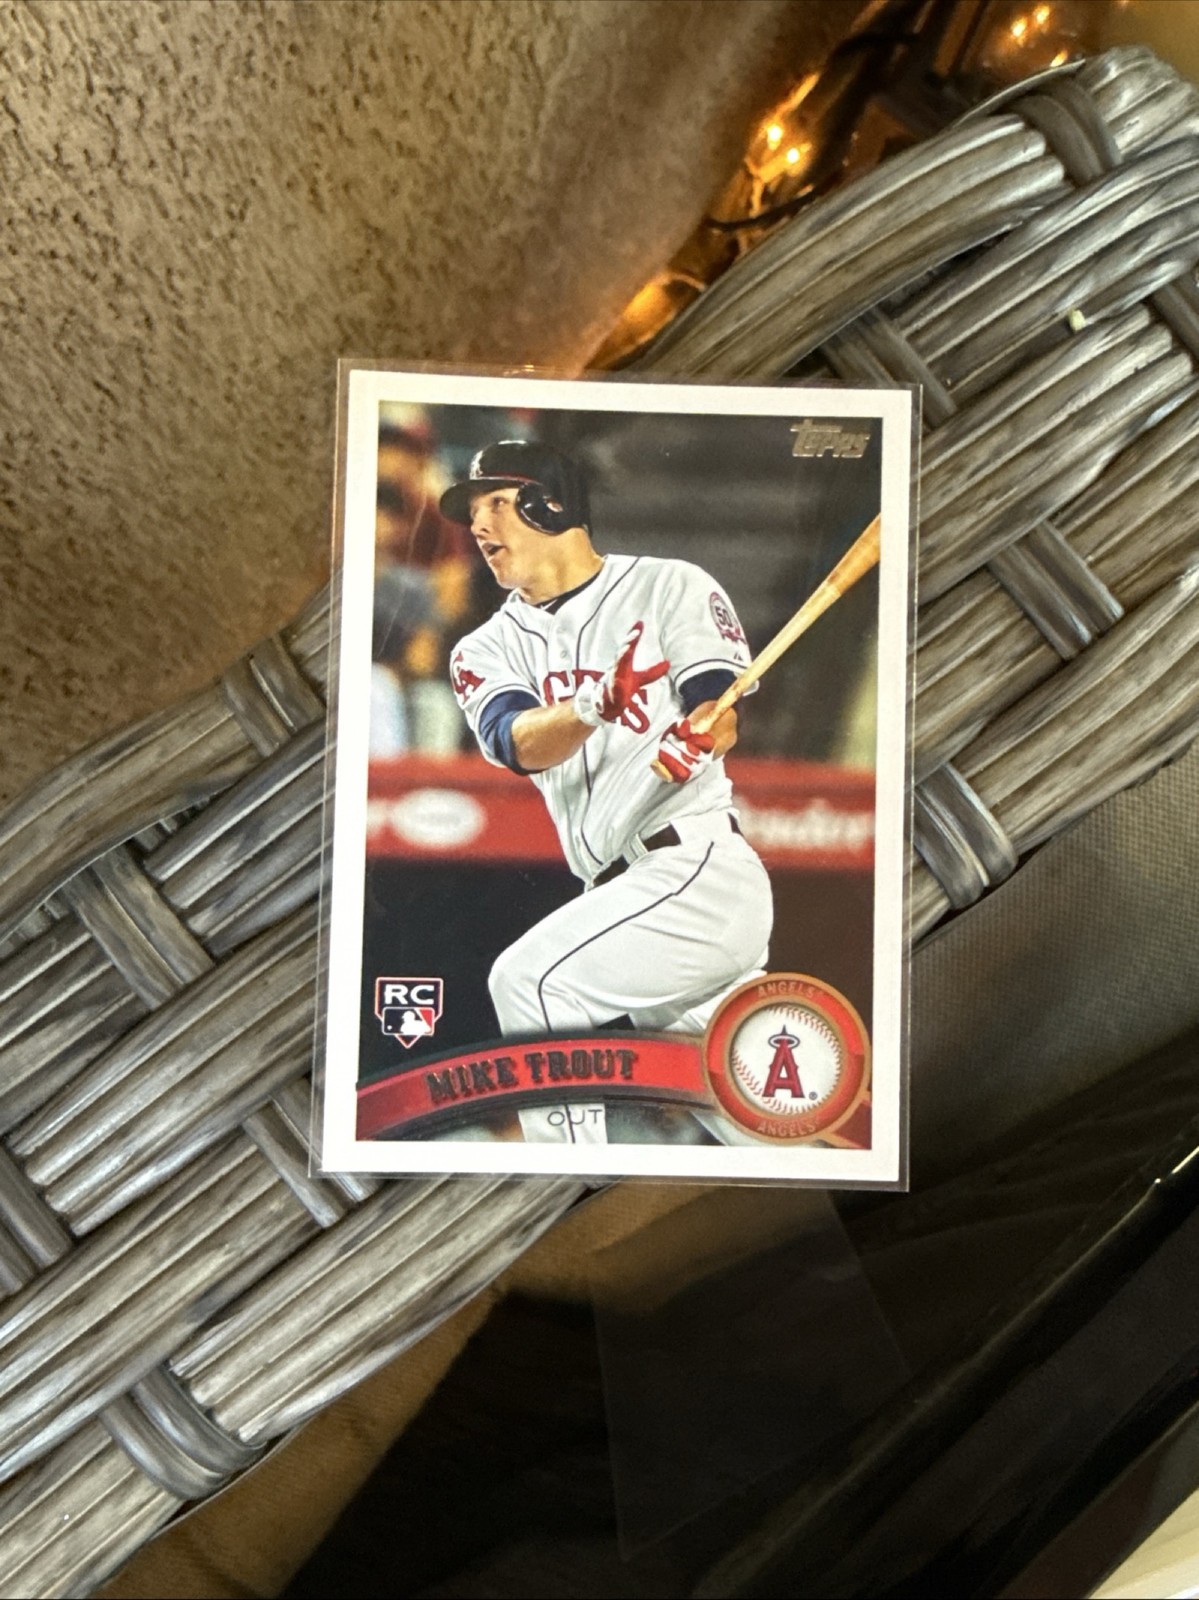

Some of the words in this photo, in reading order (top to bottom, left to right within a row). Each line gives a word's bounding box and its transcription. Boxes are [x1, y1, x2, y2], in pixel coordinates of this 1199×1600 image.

[384, 984, 435, 1005] RC
[757, 981, 814, 999] ANGELS
[426, 1060, 517, 1102] MIKE
[525, 1049, 637, 1083] TROUT
[547, 1109, 603, 1126] OUT
[757, 1119, 817, 1137] ANGELS
